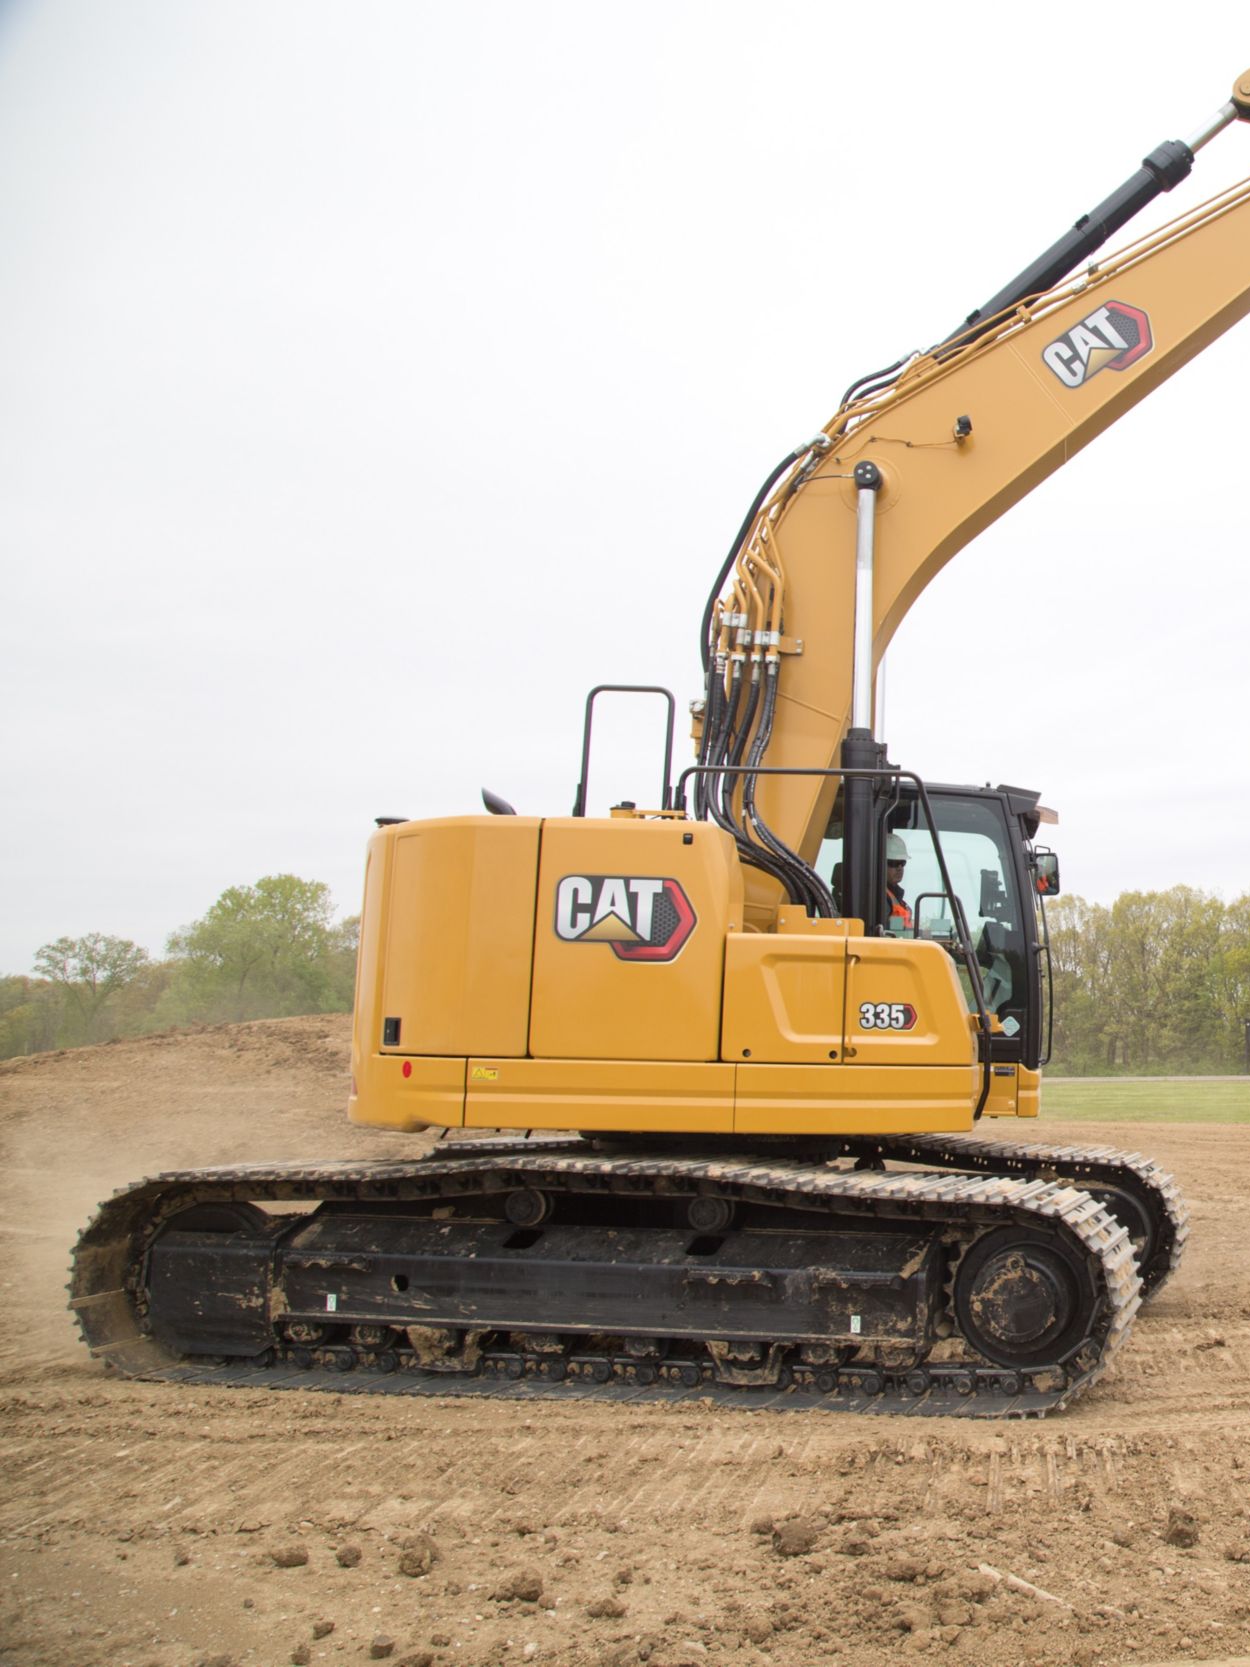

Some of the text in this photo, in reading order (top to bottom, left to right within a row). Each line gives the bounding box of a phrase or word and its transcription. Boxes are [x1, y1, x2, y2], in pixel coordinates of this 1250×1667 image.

[1043, 306, 1129, 388] CAT
[557, 876, 664, 941] CAT
[860, 1003, 905, 1029] 335
